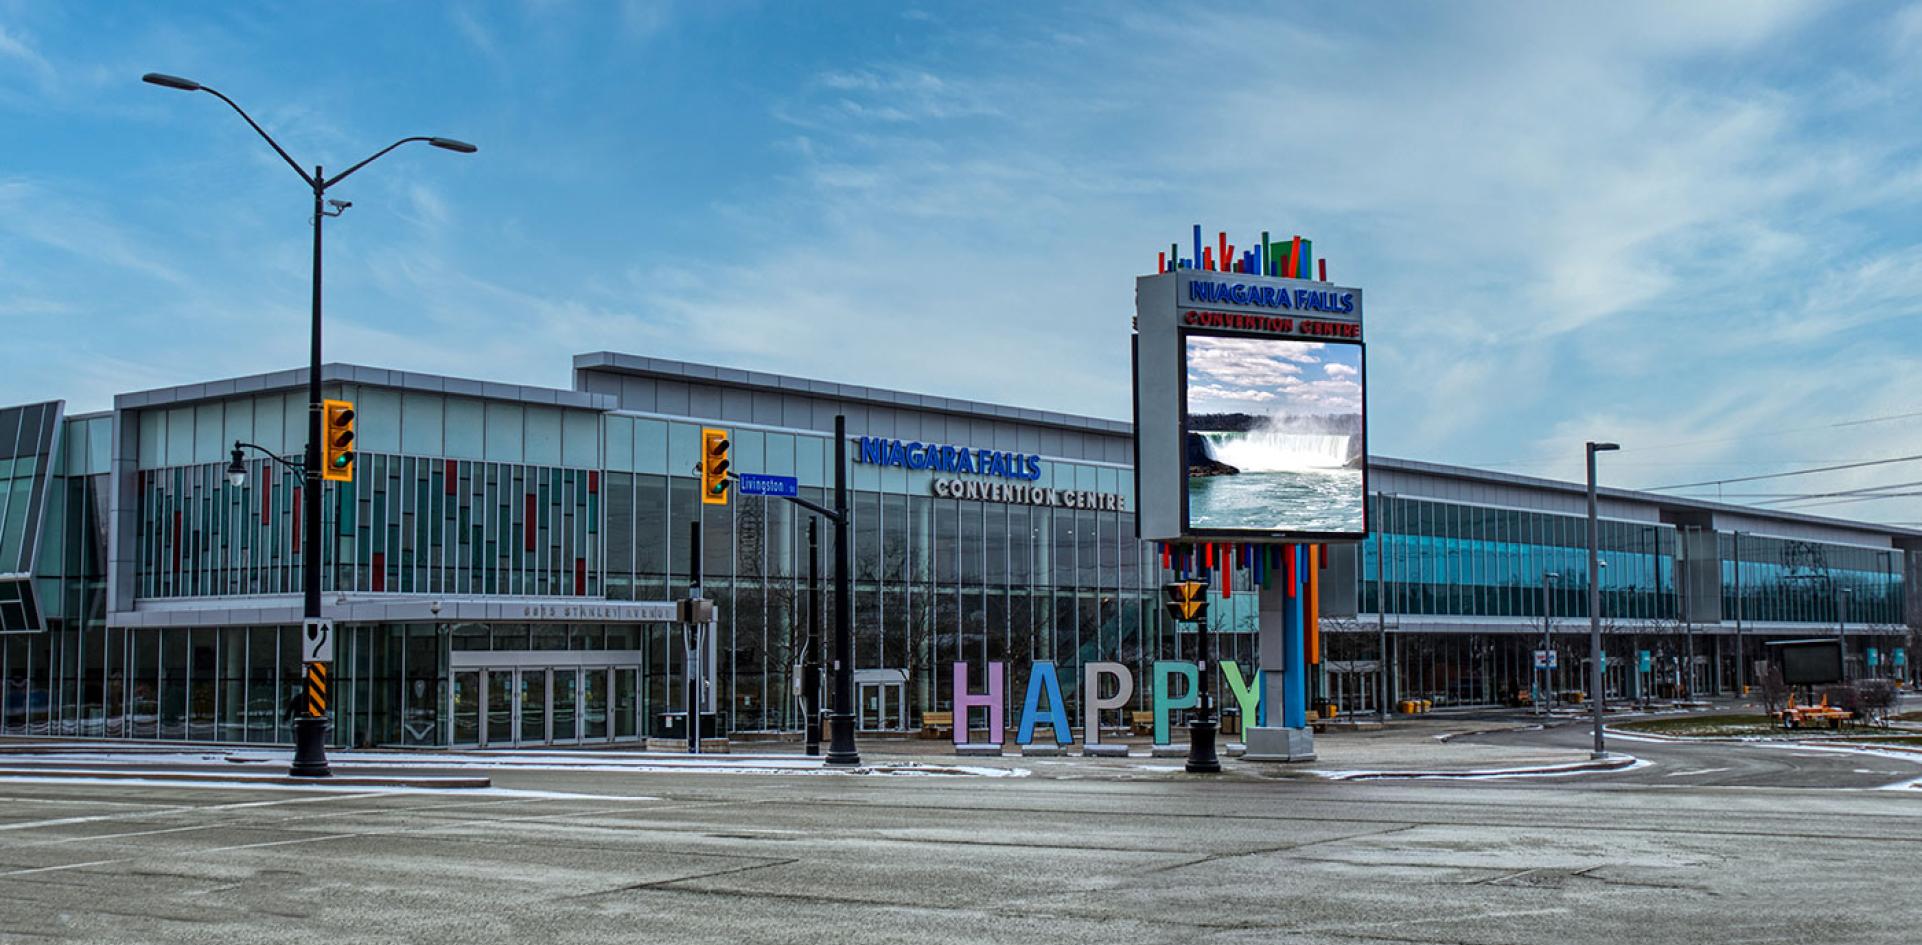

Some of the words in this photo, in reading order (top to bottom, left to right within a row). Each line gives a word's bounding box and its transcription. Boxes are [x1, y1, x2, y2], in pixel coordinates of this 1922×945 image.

[1189, 280, 1292, 309] NIAGARA
[1294, 288, 1354, 314] FALLS
[1185, 311, 1294, 332] CONVENTION
[1299, 320, 1360, 337] CENTRE
[860, 436, 975, 473] NIAGARA
[978, 449, 1042, 480] FALLS
[741, 476, 784, 495] Livingston
[933, 478, 1057, 505] CONVENTION
[1063, 490, 1125, 511] CENTRE
[564, 606, 617, 618] STANLEY
[953, 660, 1261, 745] HAPPY
